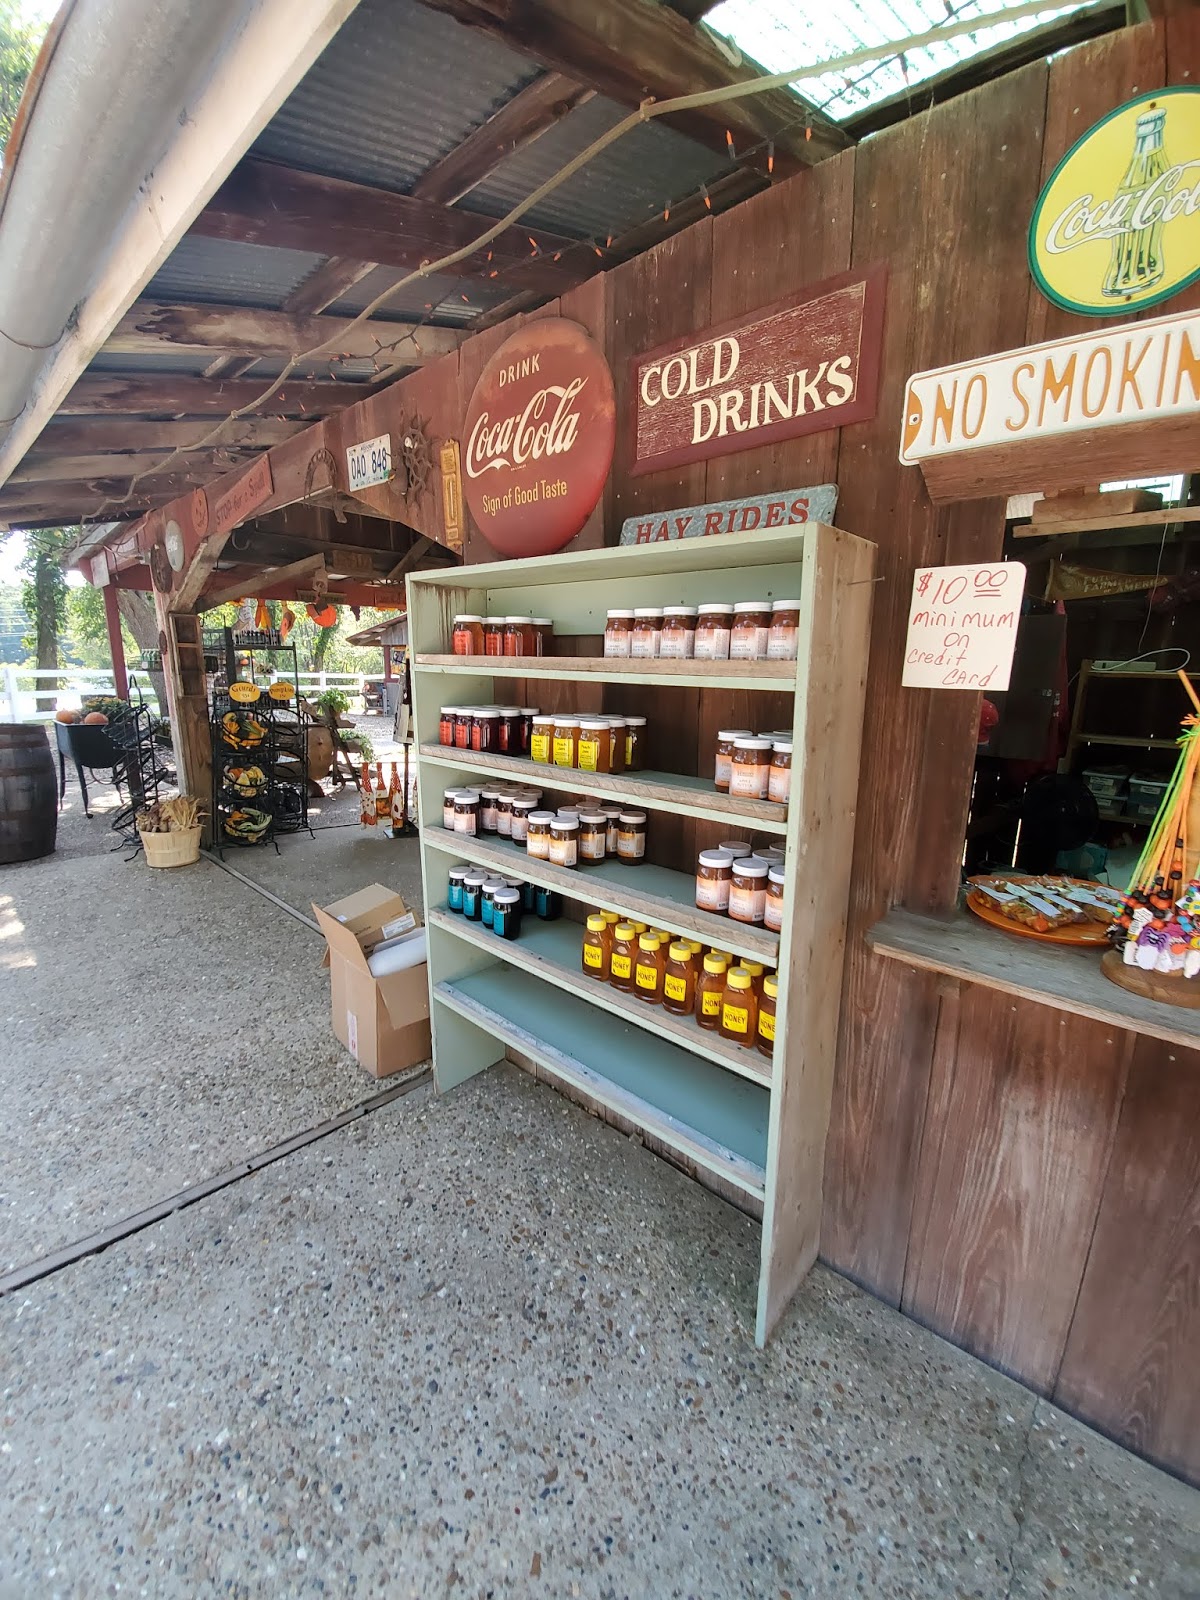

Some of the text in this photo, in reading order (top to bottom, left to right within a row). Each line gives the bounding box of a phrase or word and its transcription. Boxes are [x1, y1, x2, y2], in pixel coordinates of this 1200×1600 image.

[498, 353, 540, 388] DRINK
[640, 337, 740, 407] COLD
[690, 355, 855, 444] DRINKS
[930, 330, 1200, 446] NO SMOKIN
[465, 375, 590, 479] Coca-Cola
[371, 447, 387, 474] 848
[482, 479, 568, 517] Sign of Good Taste
[636, 498, 810, 545] HAY RIDES
[943, 632, 970, 648] on
[585, 951, 600, 961] HONEY
[612, 960, 630, 971] HONEY
[637, 971, 655, 981] HONEY
[666, 982, 684, 994] HONEY
[724, 1012, 745, 1024] HONEY
